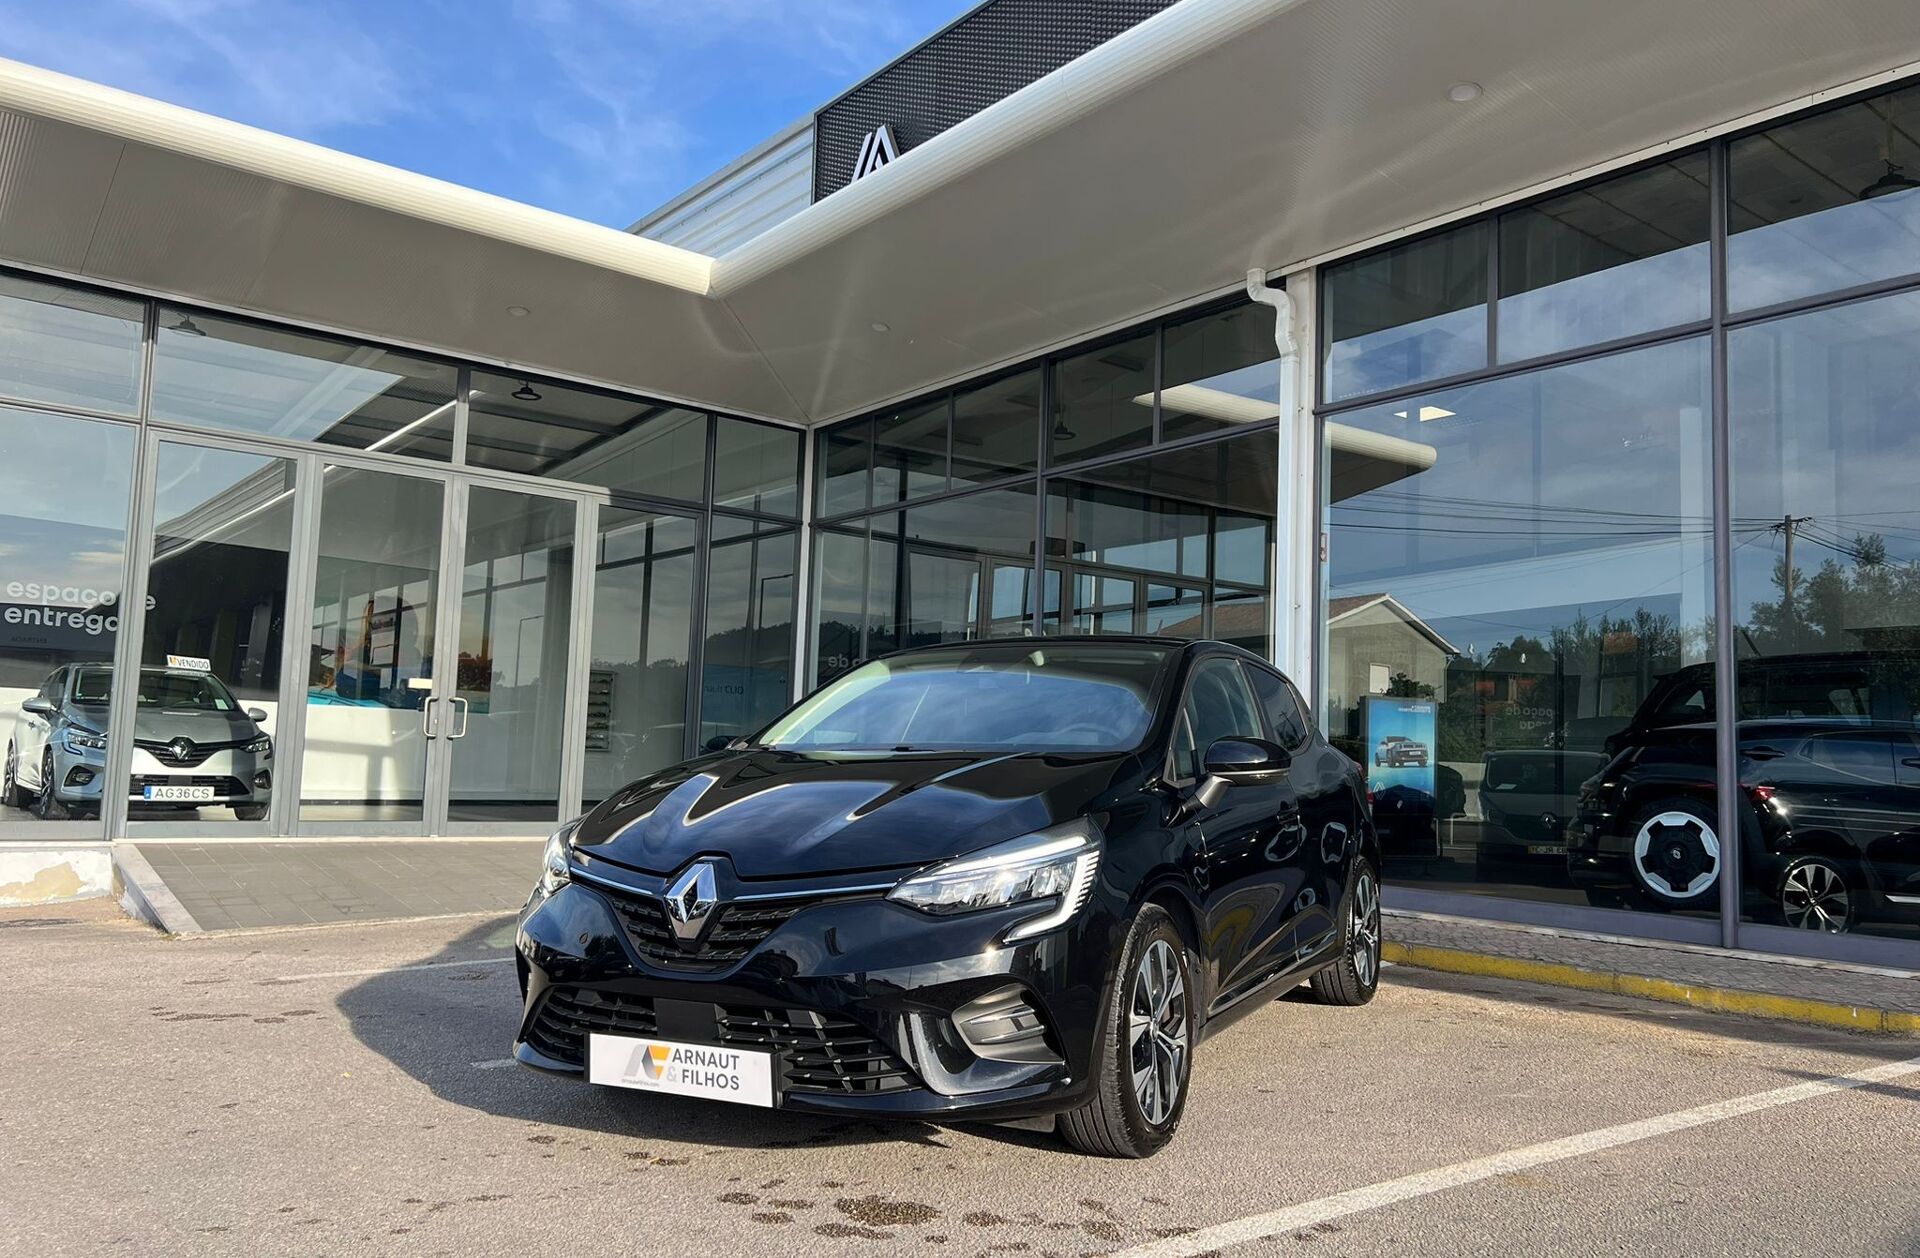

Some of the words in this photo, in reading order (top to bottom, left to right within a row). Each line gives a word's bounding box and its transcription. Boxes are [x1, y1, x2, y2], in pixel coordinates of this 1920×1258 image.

[145, 594, 157, 610] e
[176, 658, 209, 670] VENDIDO
[154, 788, 210, 799] AG36CS
[672, 1048, 740, 1071] ARNAUT
[666, 1065, 678, 1082] &
[681, 1069, 740, 1091] FILHOS
